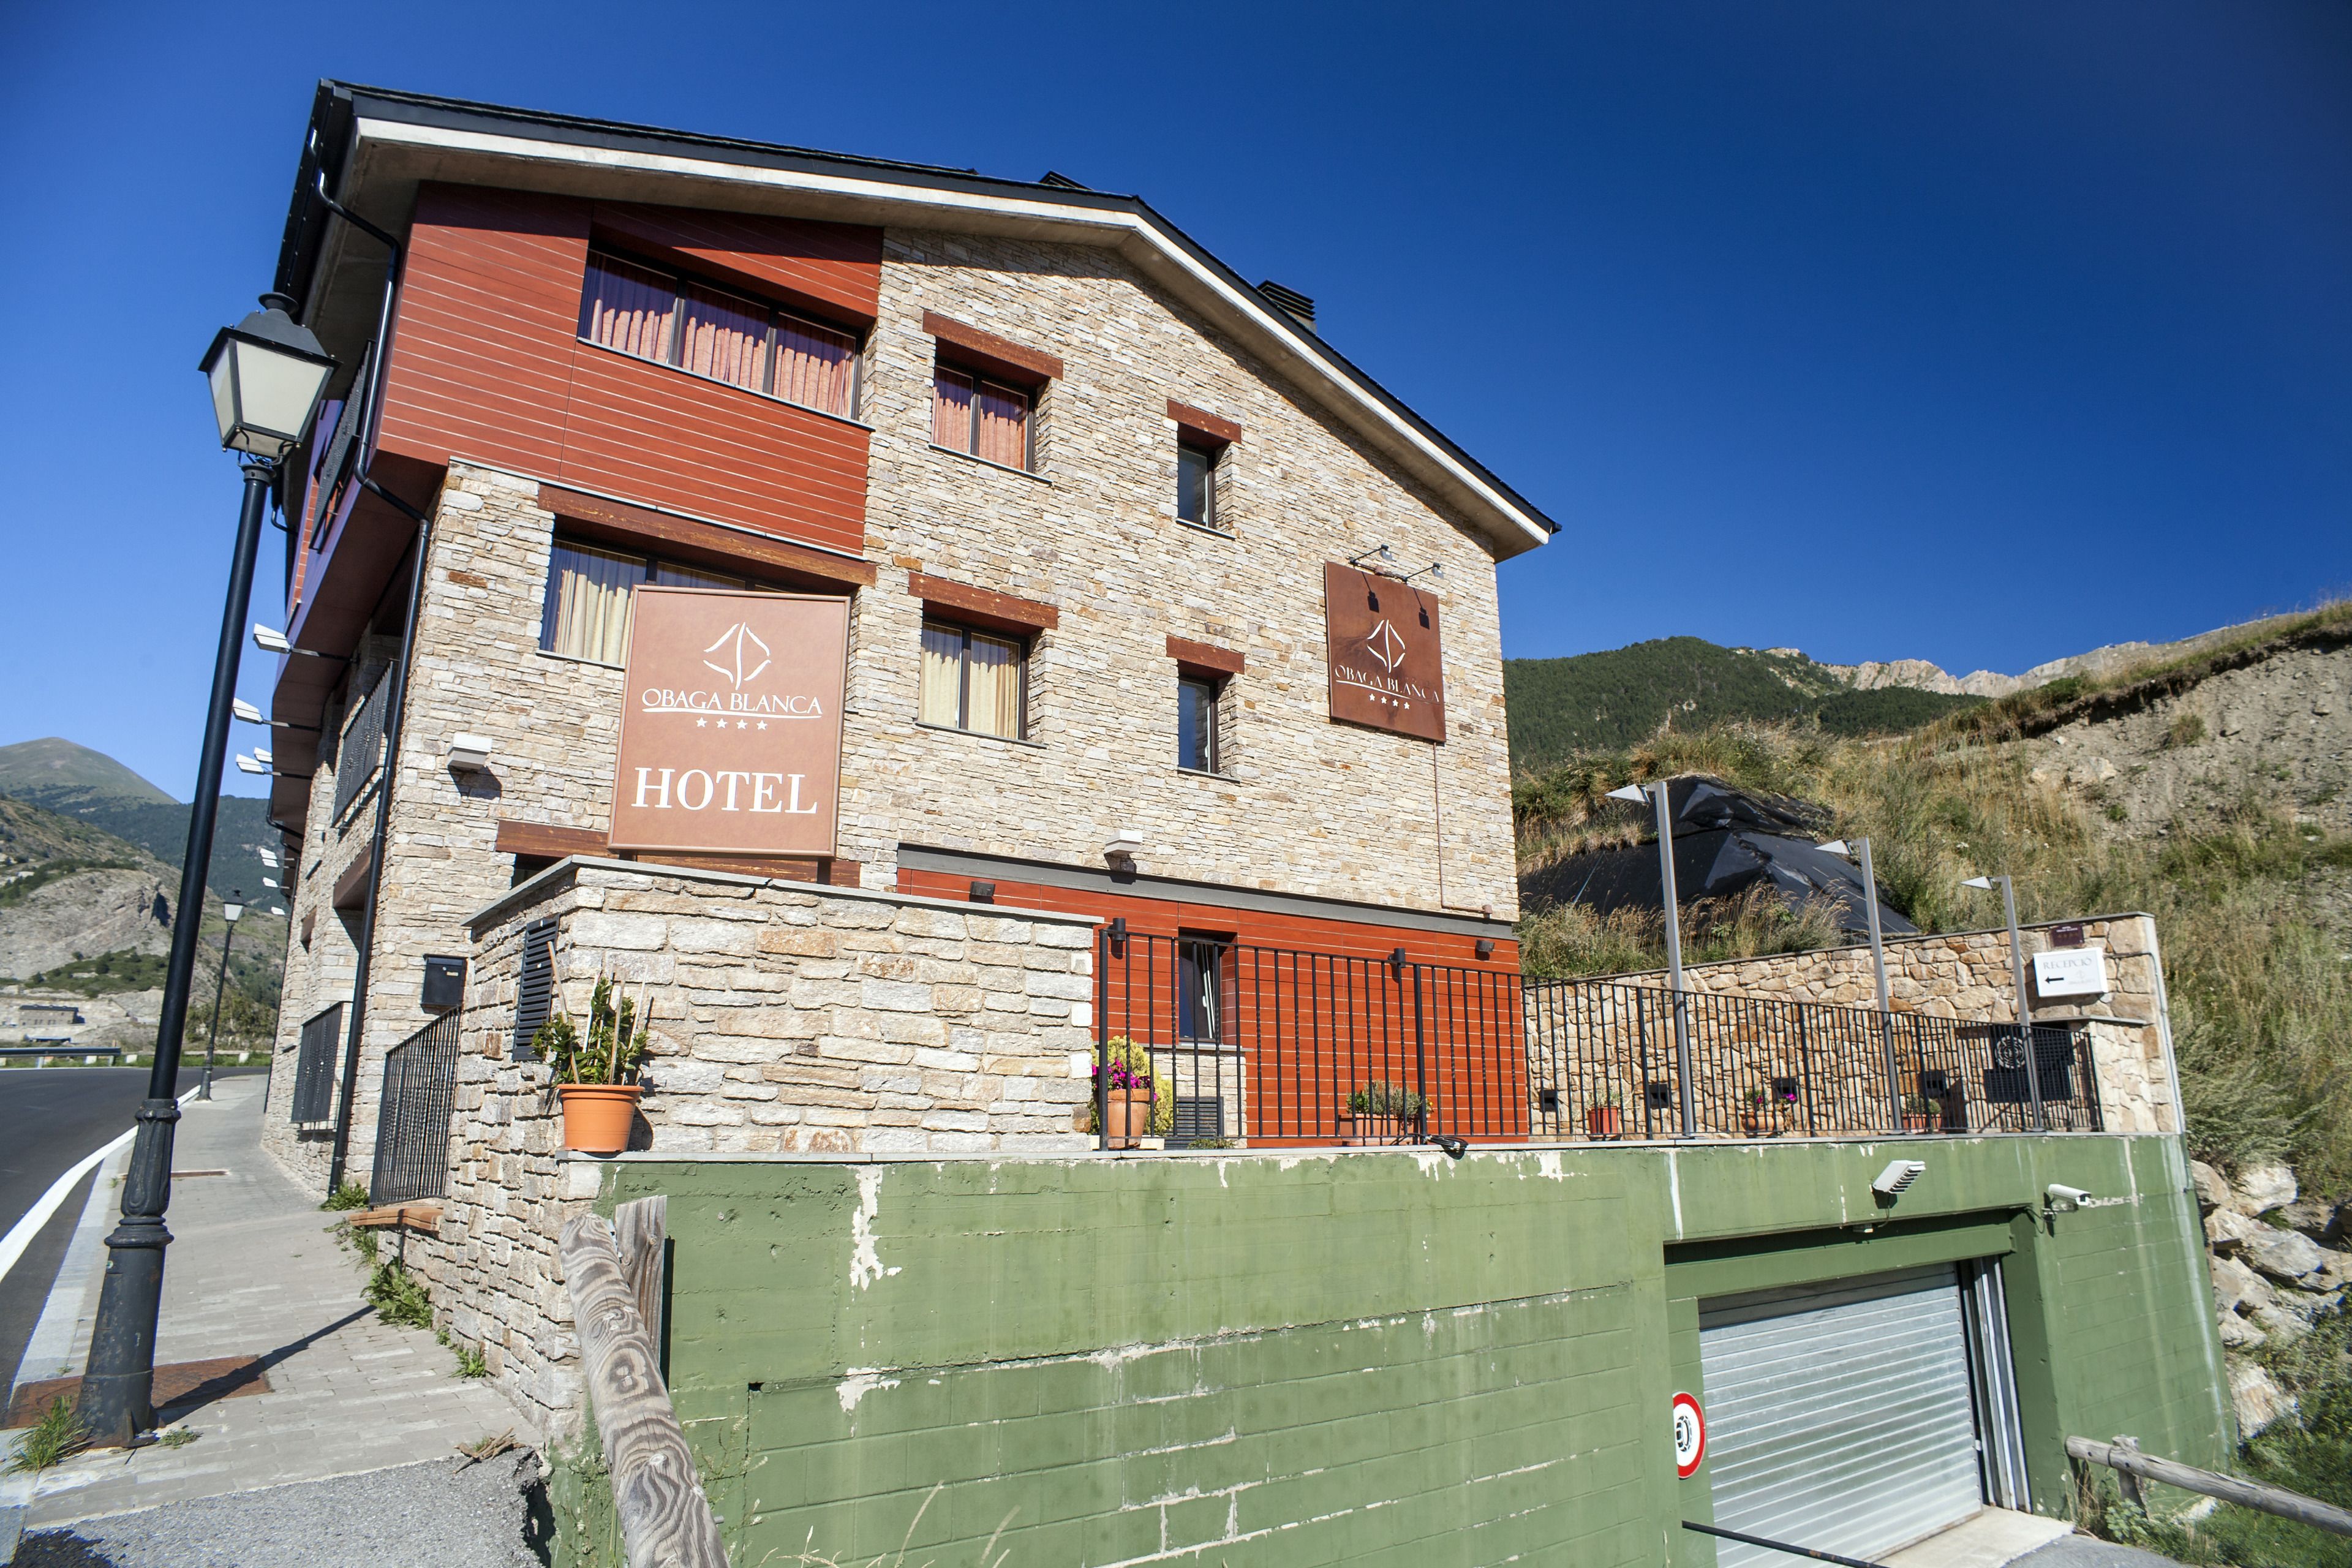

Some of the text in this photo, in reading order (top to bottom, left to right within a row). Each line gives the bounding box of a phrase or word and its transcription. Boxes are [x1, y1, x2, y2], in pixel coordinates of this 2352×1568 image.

[641, 688, 823, 714] OBAGA BLANCA
[631, 767, 818, 814] HOTEL
